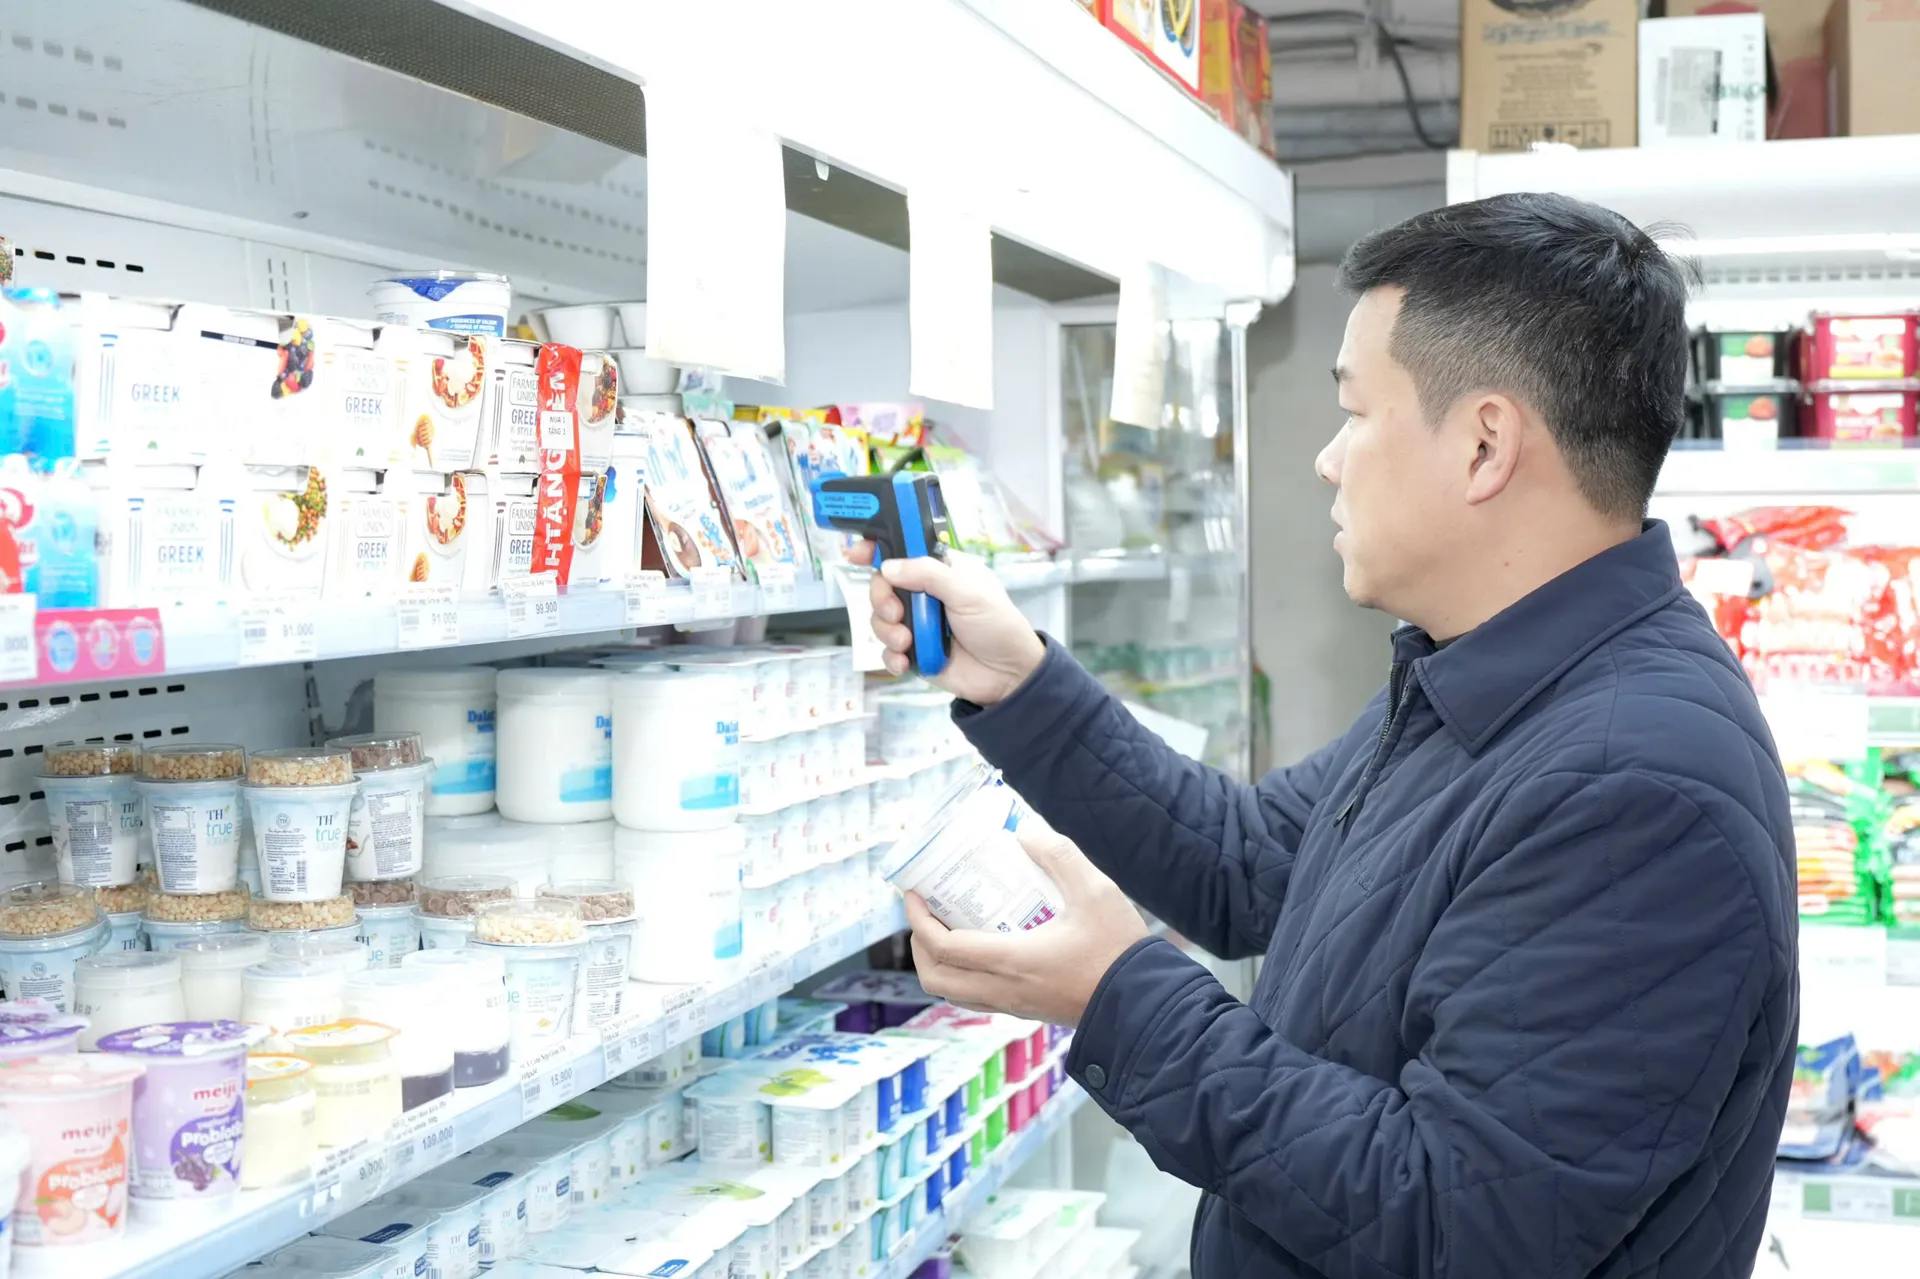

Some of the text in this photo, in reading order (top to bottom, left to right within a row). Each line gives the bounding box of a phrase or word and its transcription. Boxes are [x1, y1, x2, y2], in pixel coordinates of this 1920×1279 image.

[131, 382, 181, 403] GREEK
[345, 396, 382, 415] GREEK
[511, 408, 537, 427] GREE
[516, 427, 533, 436] STYLE
[512, 508, 537, 519] FARMER
[157, 545, 205, 564] GREEK
[357, 541, 388, 559] GREEK
[510, 539, 532, 555] GREE
[514, 556, 530, 565] STYLE
[535, 601, 558, 615] 99.900
[121, 802, 136, 814] TH
[205, 808, 224, 821] TH
[120, 815, 142, 829] true
[316, 814, 333, 827] TH
[205, 821, 233, 837] true
[315, 827, 341, 842] true
[120, 938, 137, 950] TH
[550, 1067, 573, 1087] 15.900
[192, 1079, 237, 1101] meiji
[61, 1117, 112, 1140] meiji
[421, 1124, 454, 1151] 139.000
